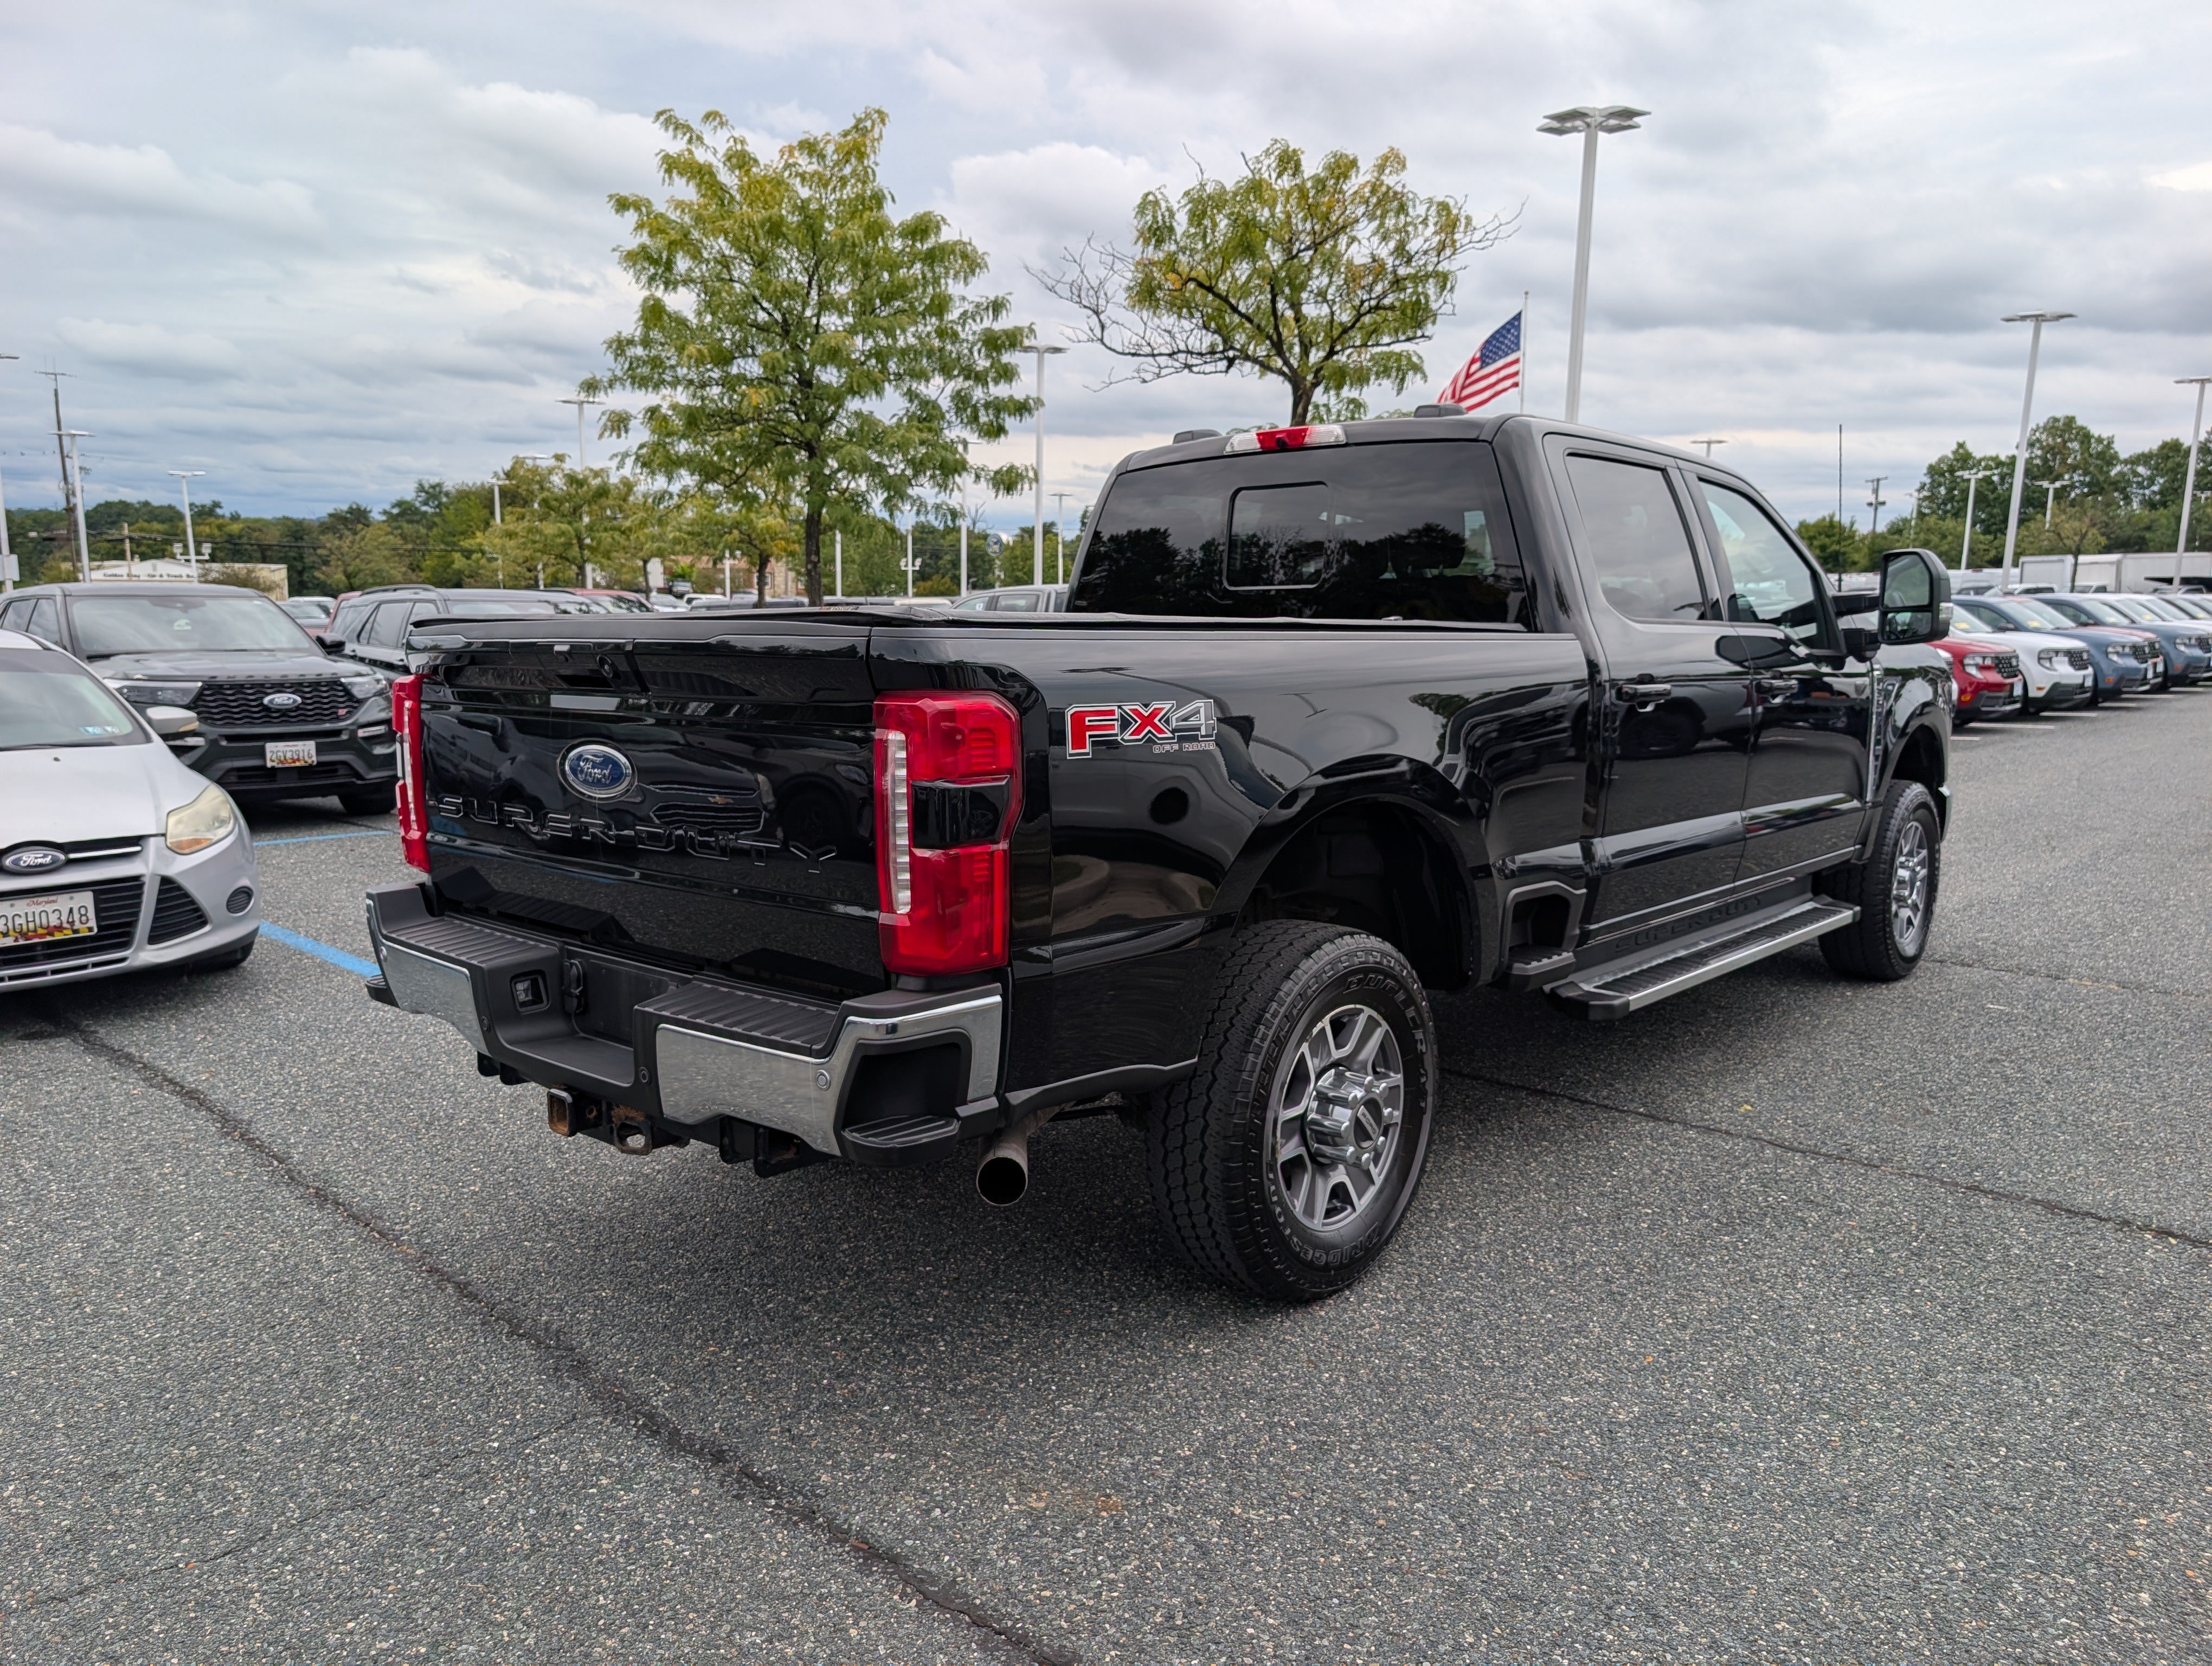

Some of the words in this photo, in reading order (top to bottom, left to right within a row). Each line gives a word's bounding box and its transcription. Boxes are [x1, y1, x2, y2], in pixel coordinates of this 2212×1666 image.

[1065, 700, 1217, 759] FX4
[269, 748, 313, 762] 2GV3916
[1153, 744, 1179, 753] OFF
[1182, 741, 1216, 751] ROAD
[577, 754, 613, 784] Ford
[435, 793, 616, 844] SUPER
[634, 821, 837, 874] DUTY
[20, 853, 53, 867] Ford
[28, 896, 58, 906] Maryland
[0, 905, 89, 934] 3GH0348
[1616, 915, 1702, 952] SUPER
[1361, 1112, 1377, 1135] FORD
[1265, 1159, 1380, 1266] BRIDGESTONE
